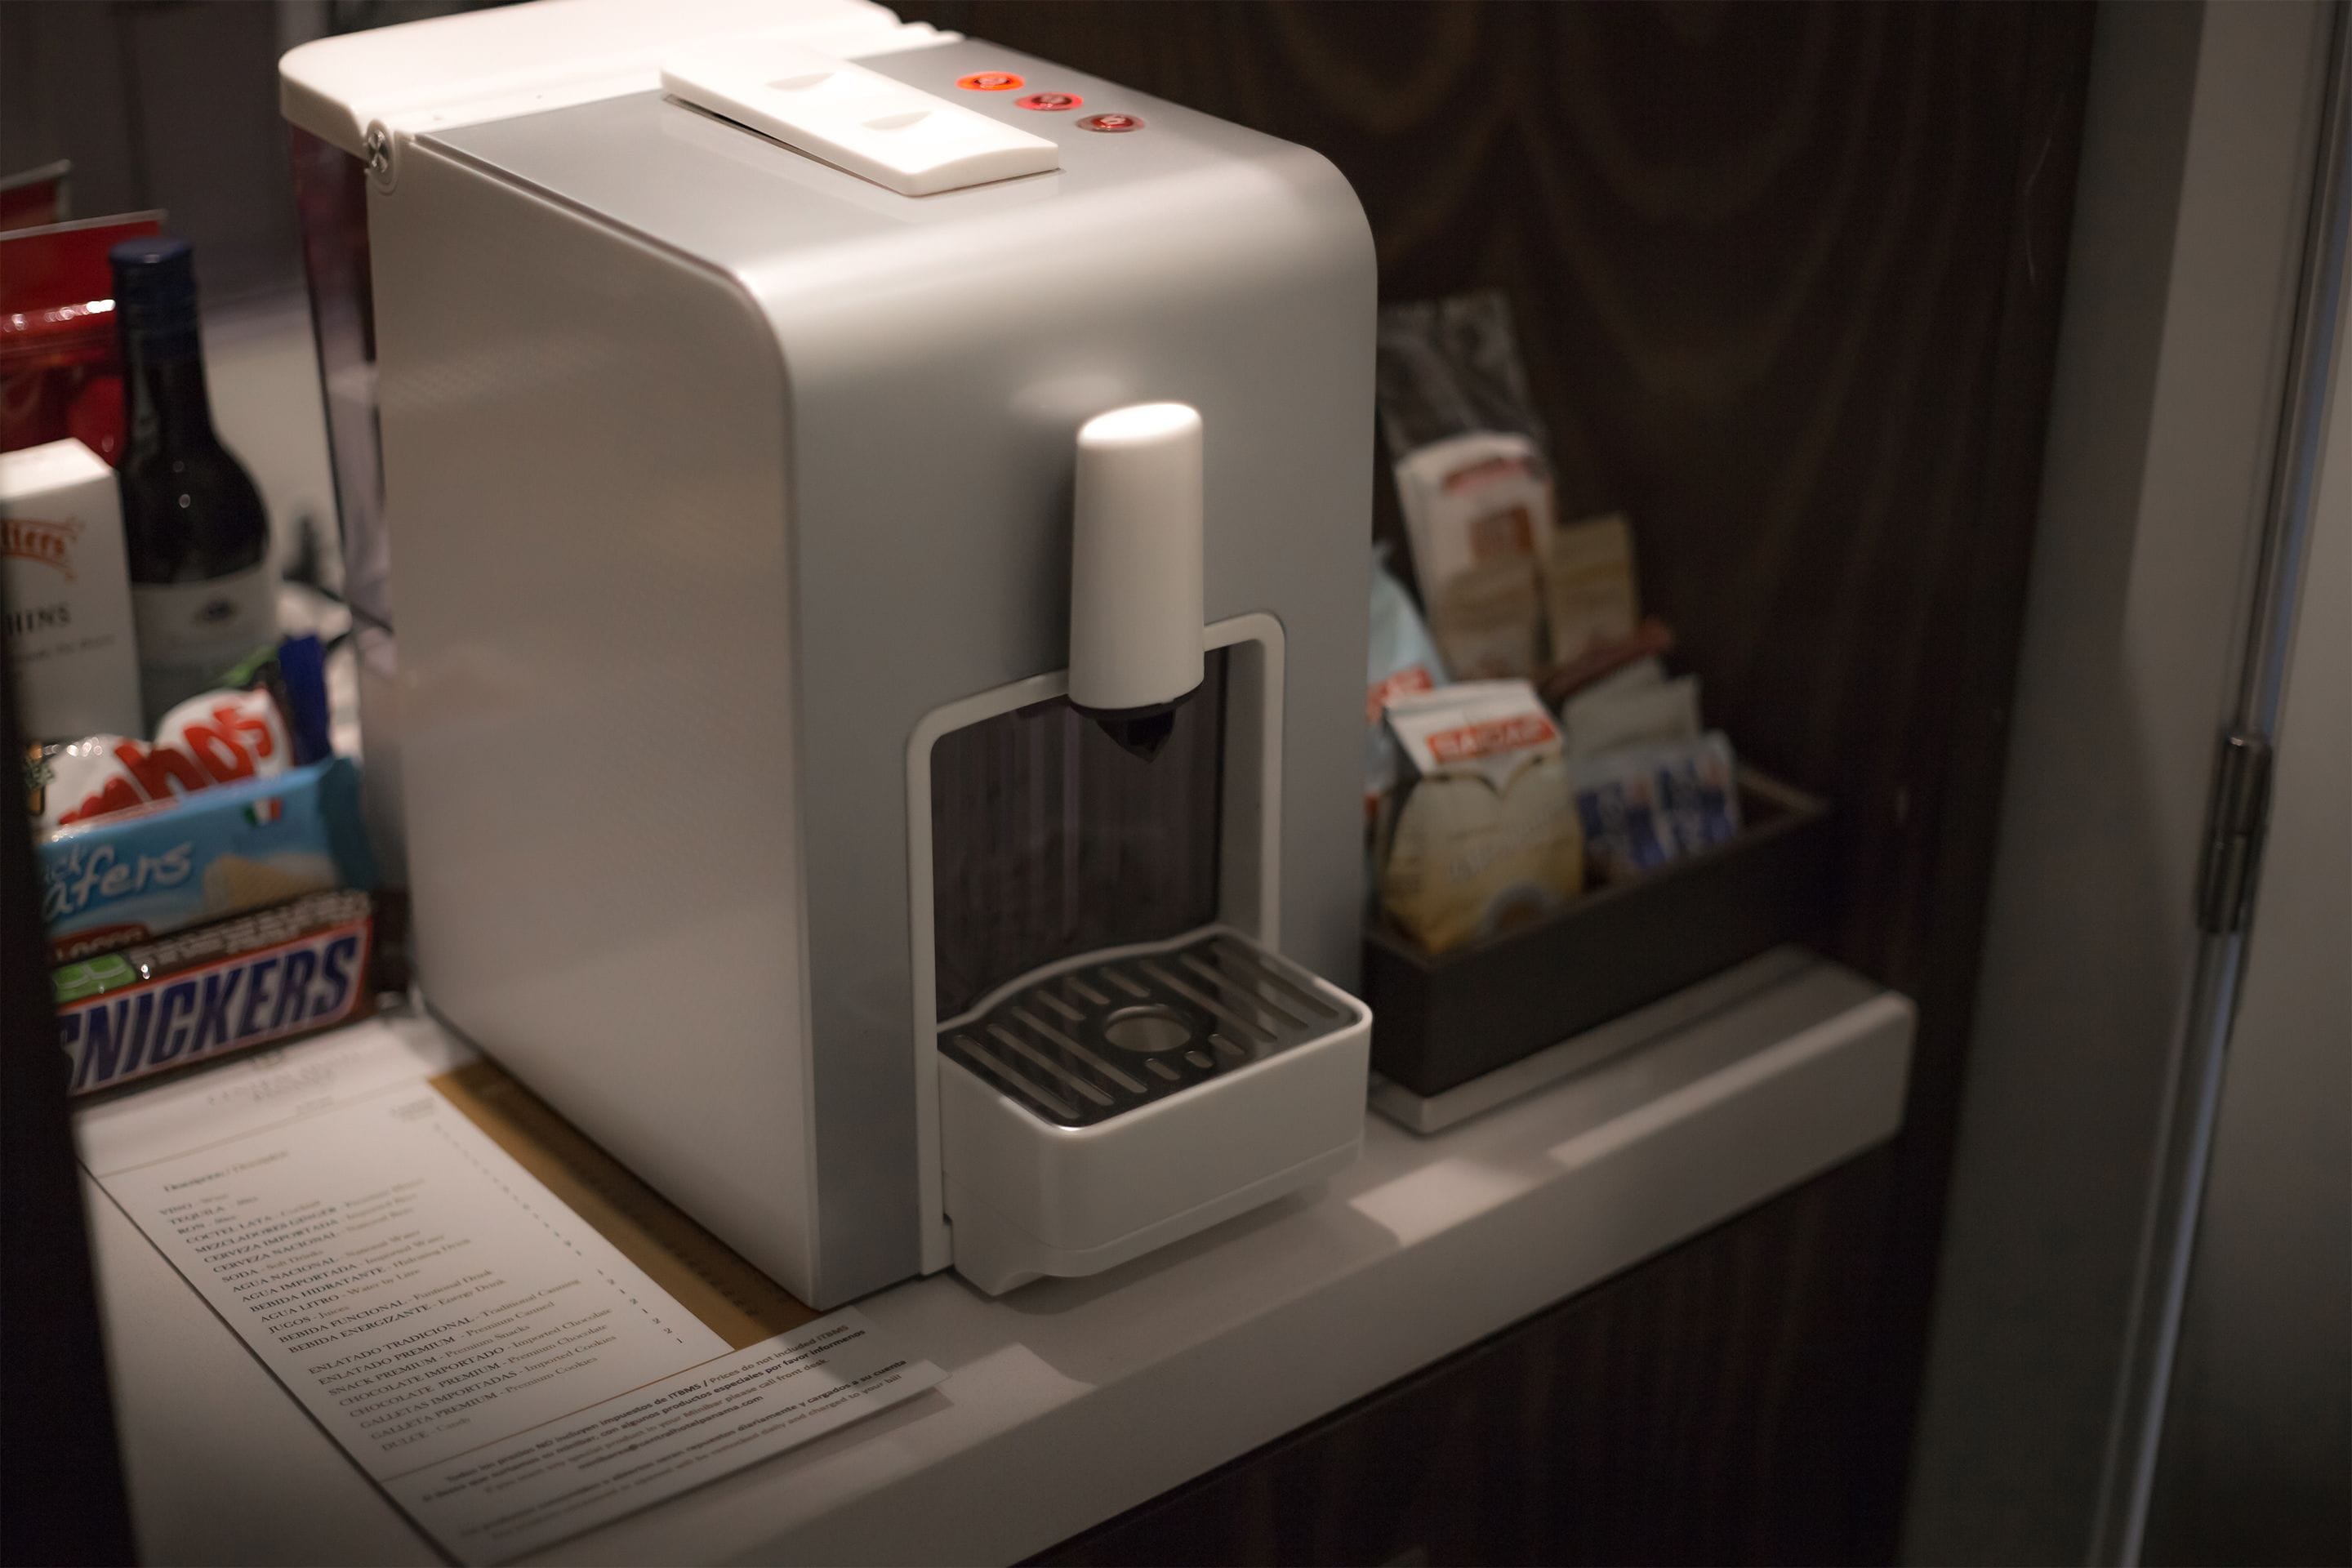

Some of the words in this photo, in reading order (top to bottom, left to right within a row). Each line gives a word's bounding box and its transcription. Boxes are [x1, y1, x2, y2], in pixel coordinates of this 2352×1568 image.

[212, 1254, 271, 1273] CERVEZA
[221, 1269, 259, 1282] SODA
[233, 1278, 269, 1293] AGUA
[270, 1257, 339, 1281] NACIONAL
[243, 1288, 278, 1303] AGUA
[278, 1263, 358, 1291] IMPORTADA
[249, 1294, 300, 1312] BEBIDA
[301, 1267, 382, 1298] HIDRATANTE
[261, 1307, 298, 1323] AGUA
[298, 1294, 340, 1311] LITRO
[268, 1316, 311, 1334] JUGOS
[278, 1325, 329, 1343] BEBIDA
[329, 1299, 408, 1328] FUNCIONAL
[287, 1334, 339, 1353] BEBIDA
[339, 1304, 432, 1338] ENERGIZANTE
[308, 1348, 382, 1374] ENLATADO
[382, 1317, 474, 1350] TRADICIONAL
[479, 1294, 537, 1317] Traditional
[318, 1357, 393, 1386] ENLATADO
[394, 1336, 456, 1361] PREMIUM
[465, 1316, 514, 1337] Premium
[328, 1377, 375, 1396] SNACK
[375, 1356, 438, 1381] PREMIUM
[444, 1339, 494, 1358] Premium
[493, 1325, 531, 1341] Snacks
[339, 1374, 425, 1406] CHOCOLATE
[424, 1347, 505, 1379] IMPORTADO
[510, 1326, 562, 1348] Imported
[350, 1385, 435, 1418] CHOCOLATE
[438, 1362, 501, 1388] PREMIUM
[506, 1344, 557, 1364] Premium
[556, 1325, 607, 1346] Chocolate
[359, 1401, 430, 1429] GALLETAS
[430, 1370, 518, 1405] IMPORTADAS
[523, 1349, 574, 1372] Imported
[574, 1335, 617, 1353] Cookies
[370, 1414, 435, 1441] GALLETA
[434, 1392, 498, 1419] PREMIUM
[504, 1373, 555, 1393] Premium
[555, 1357, 598, 1374] Cookies
[599, 1403, 653, 1426] impuestos
[653, 1397, 668, 1405] de
[709, 1370, 741, 1384] Prices
[741, 1364, 755, 1372] do
[755, 1356, 775, 1365] not
[773, 1338, 817, 1359] included
[599, 1427, 620, 1437] con
[620, 1411, 661, 1430] algunos
[662, 1391, 713, 1414] productos
[713, 1371, 764, 1393] especiales
[764, 1363, 782, 1374] por
[782, 1352, 809, 1366] favor
[808, 1330, 866, 1356] informenos
[724, 1387, 758, 1403] please
[758, 1378, 777, 1389] call
[776, 1369, 804, 1381] front
[737, 1405, 798, 1432] diariamente
[807, 1383, 852, 1404] cargados
[872, 1360, 907, 1376] cuenta
[808, 1396, 849, 1416] charged
[860, 1382, 884, 1395] your
[883, 1374, 902, 1384] bill
